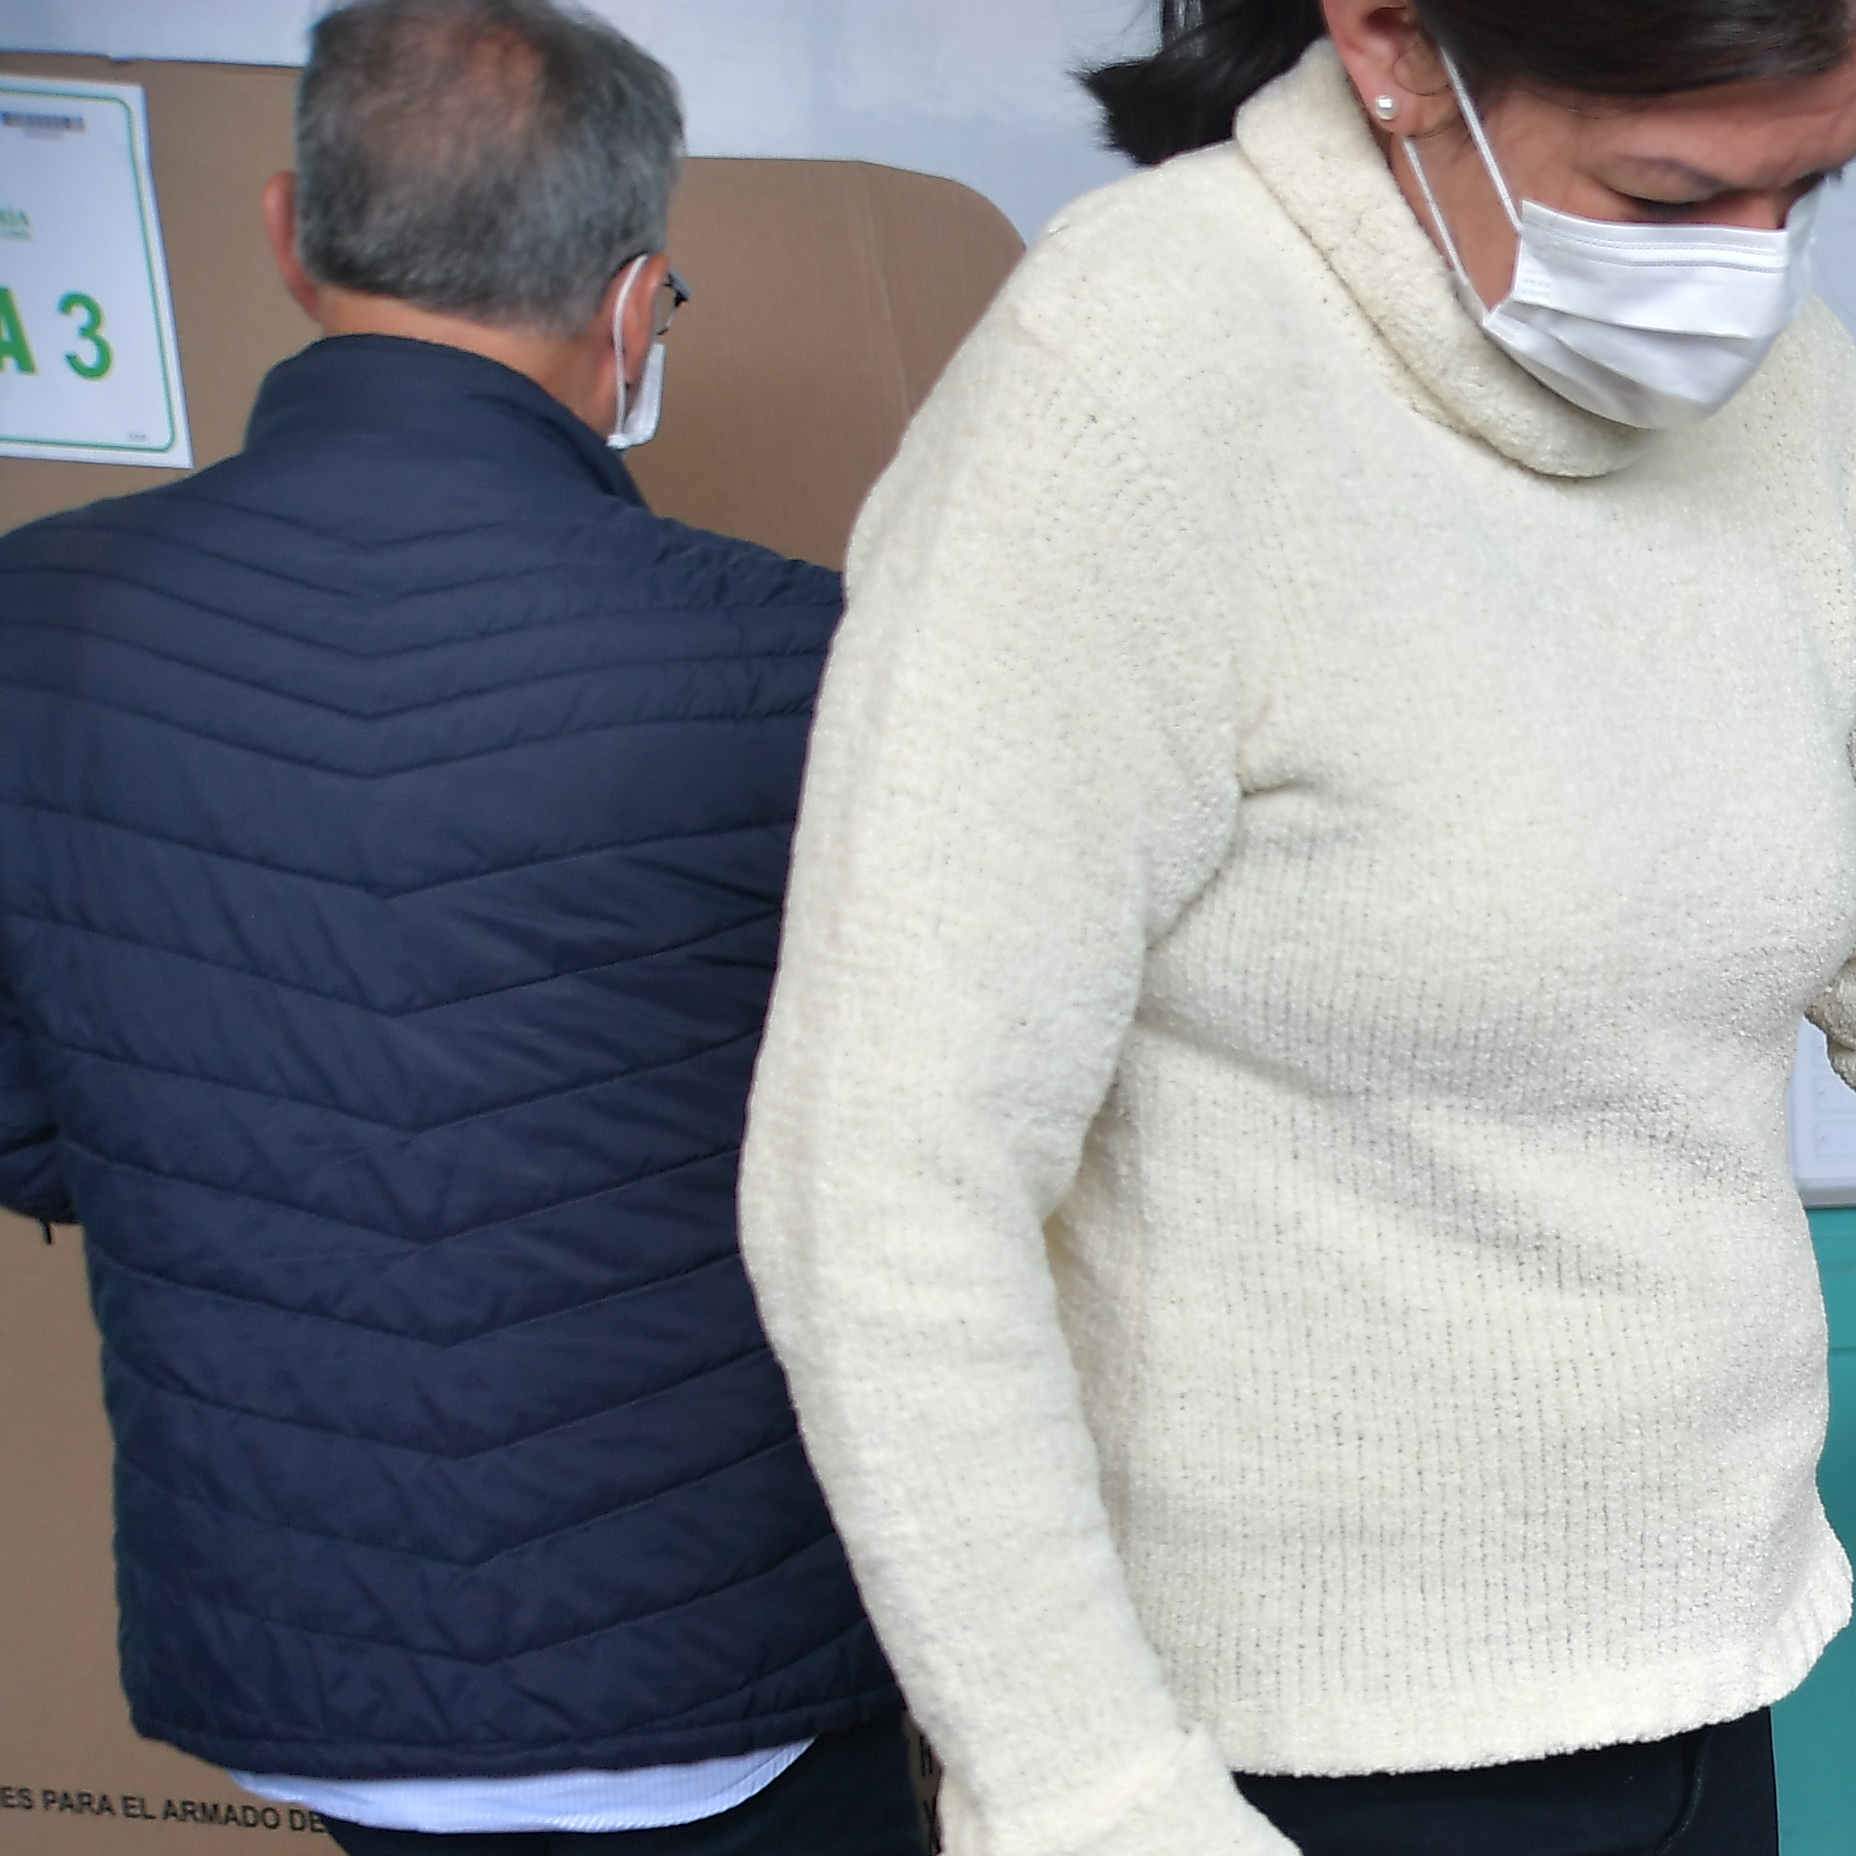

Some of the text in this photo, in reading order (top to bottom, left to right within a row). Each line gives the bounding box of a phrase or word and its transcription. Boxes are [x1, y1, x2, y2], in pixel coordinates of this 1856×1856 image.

[57, 290, 112, 378] 3
[42, 1789, 115, 1816] PARA
[121, 1795, 156, 1820] EL
[163, 1799, 281, 1830] ARMADO
